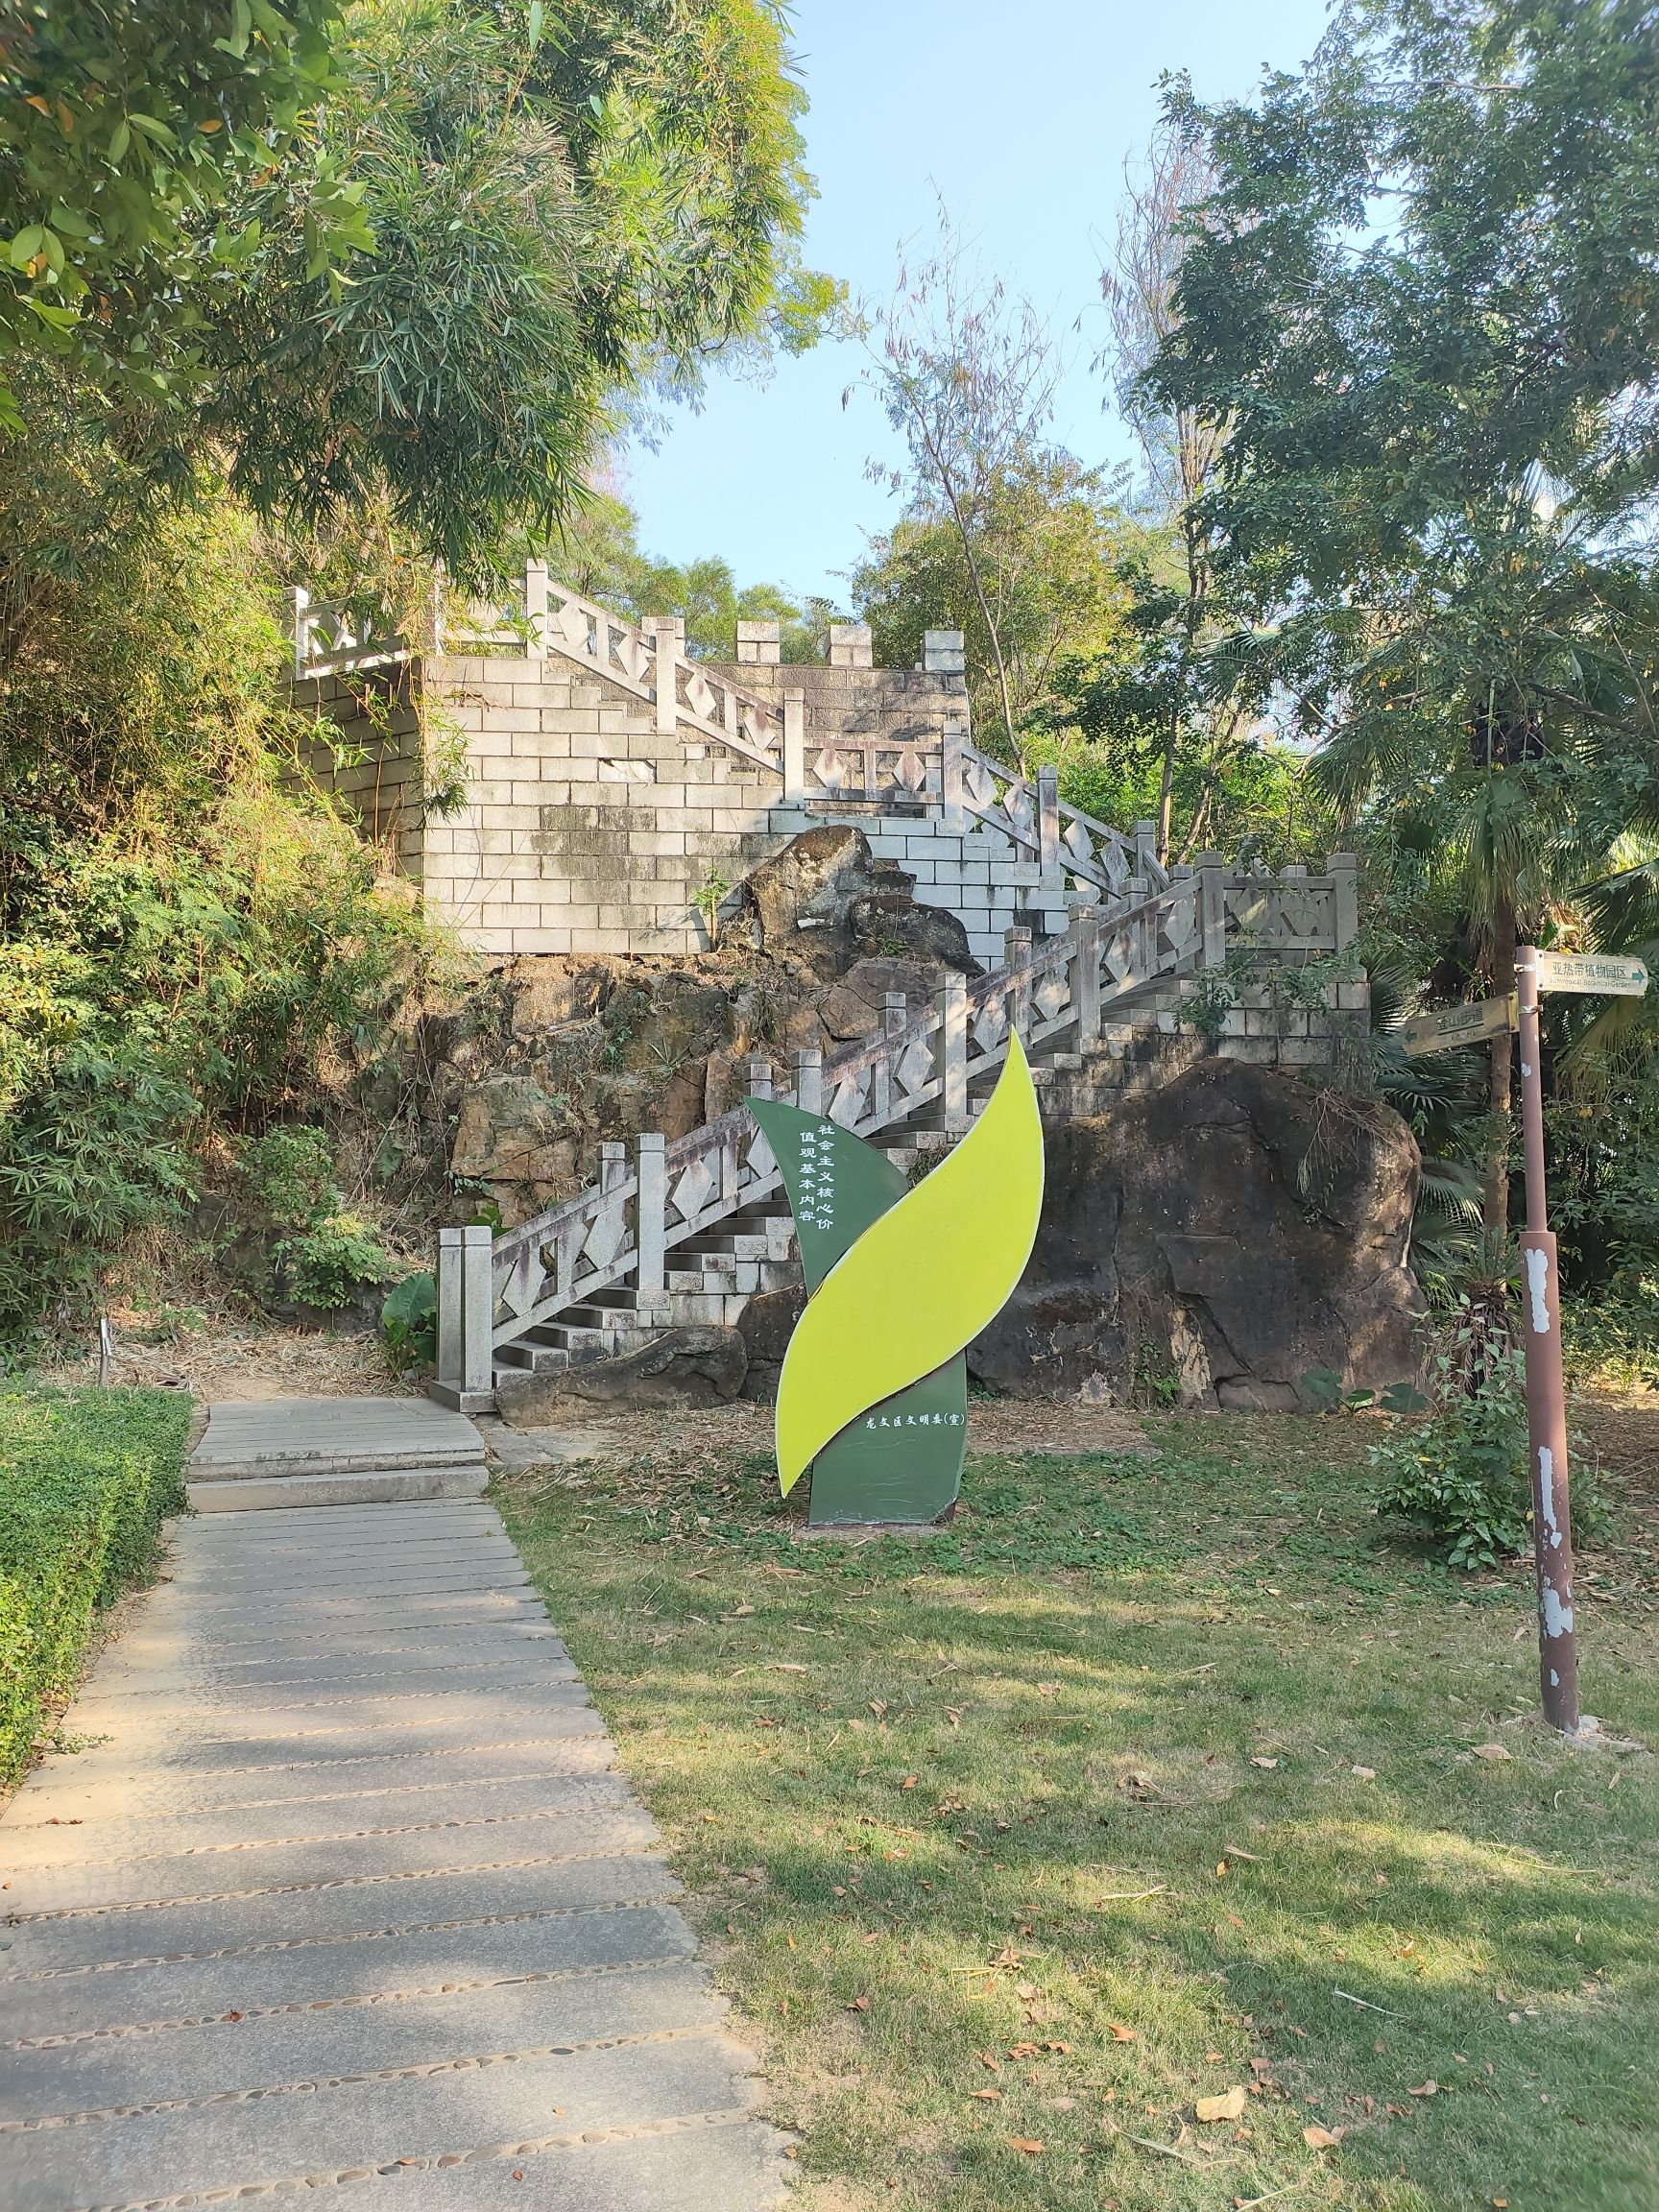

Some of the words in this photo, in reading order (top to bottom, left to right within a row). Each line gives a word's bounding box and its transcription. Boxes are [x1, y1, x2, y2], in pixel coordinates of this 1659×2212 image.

[1552, 961, 1626, 978] 亚热带植物园区
[798, 1131, 817, 1222] 值观基本内容
[816, 1124, 835, 1230] 社会主义核心价
